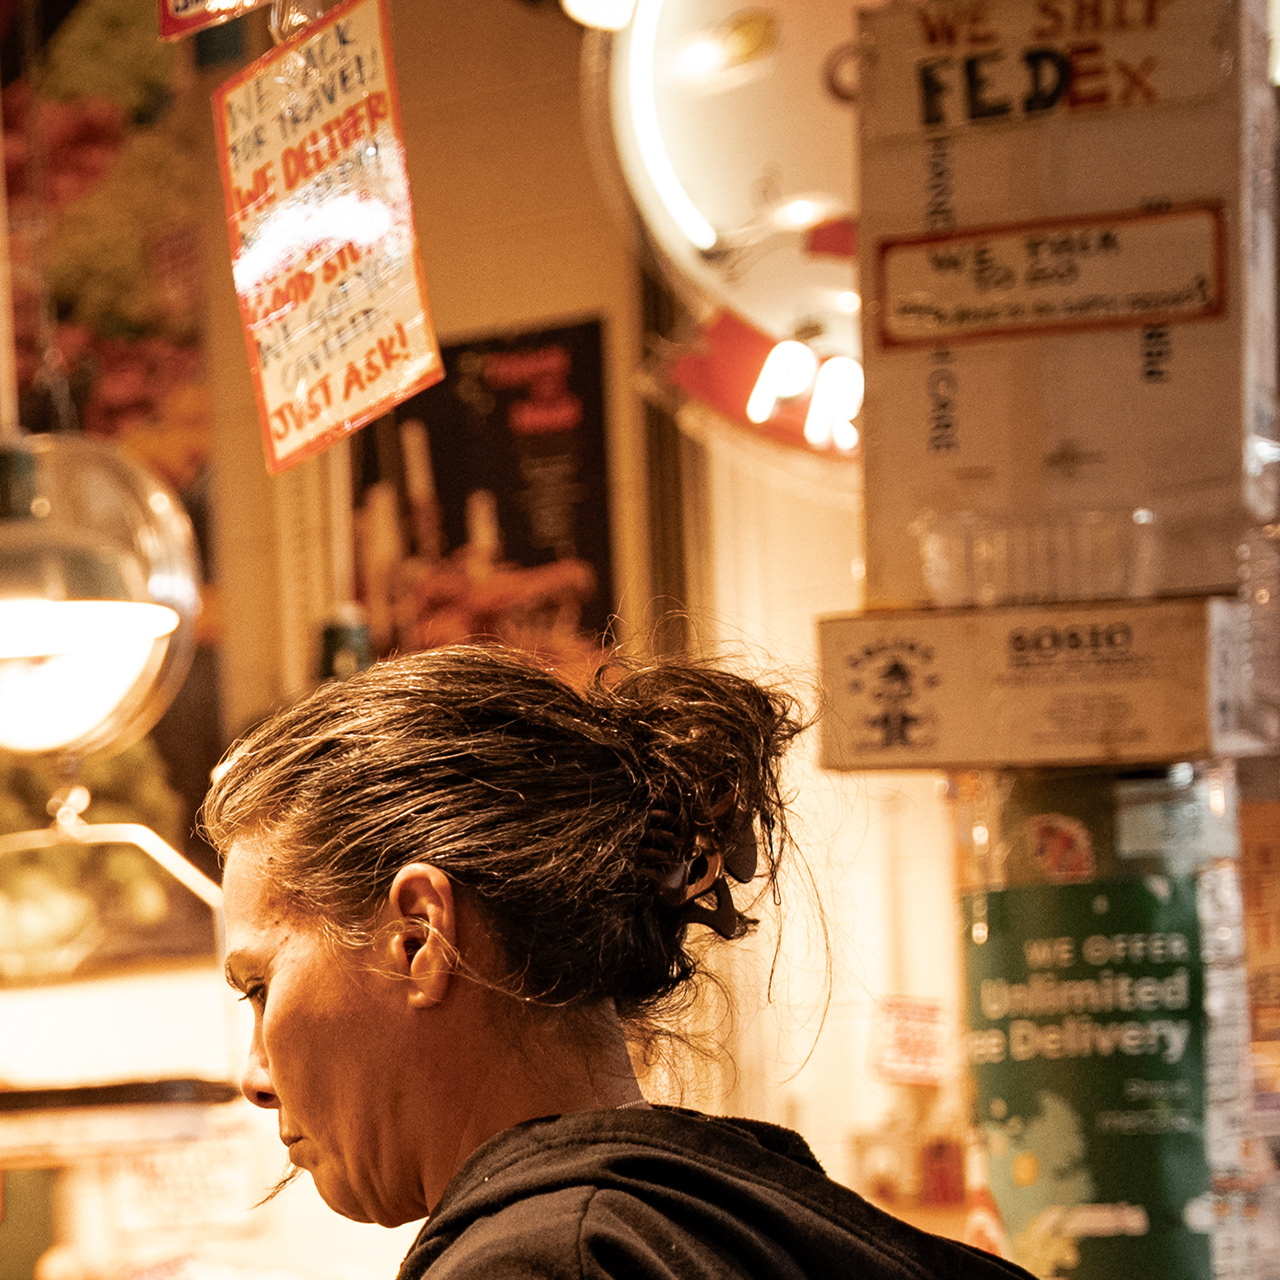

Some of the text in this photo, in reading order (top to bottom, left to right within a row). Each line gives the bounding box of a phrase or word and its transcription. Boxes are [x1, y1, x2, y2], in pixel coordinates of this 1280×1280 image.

[234, 160, 277, 222] WE
[280, 91, 387, 191] DELIVER
[269, 320, 412, 441] JUST ASK!
[981, 967, 1189, 1020] Unlimited
[1009, 1015, 1190, 1064] Delivery
